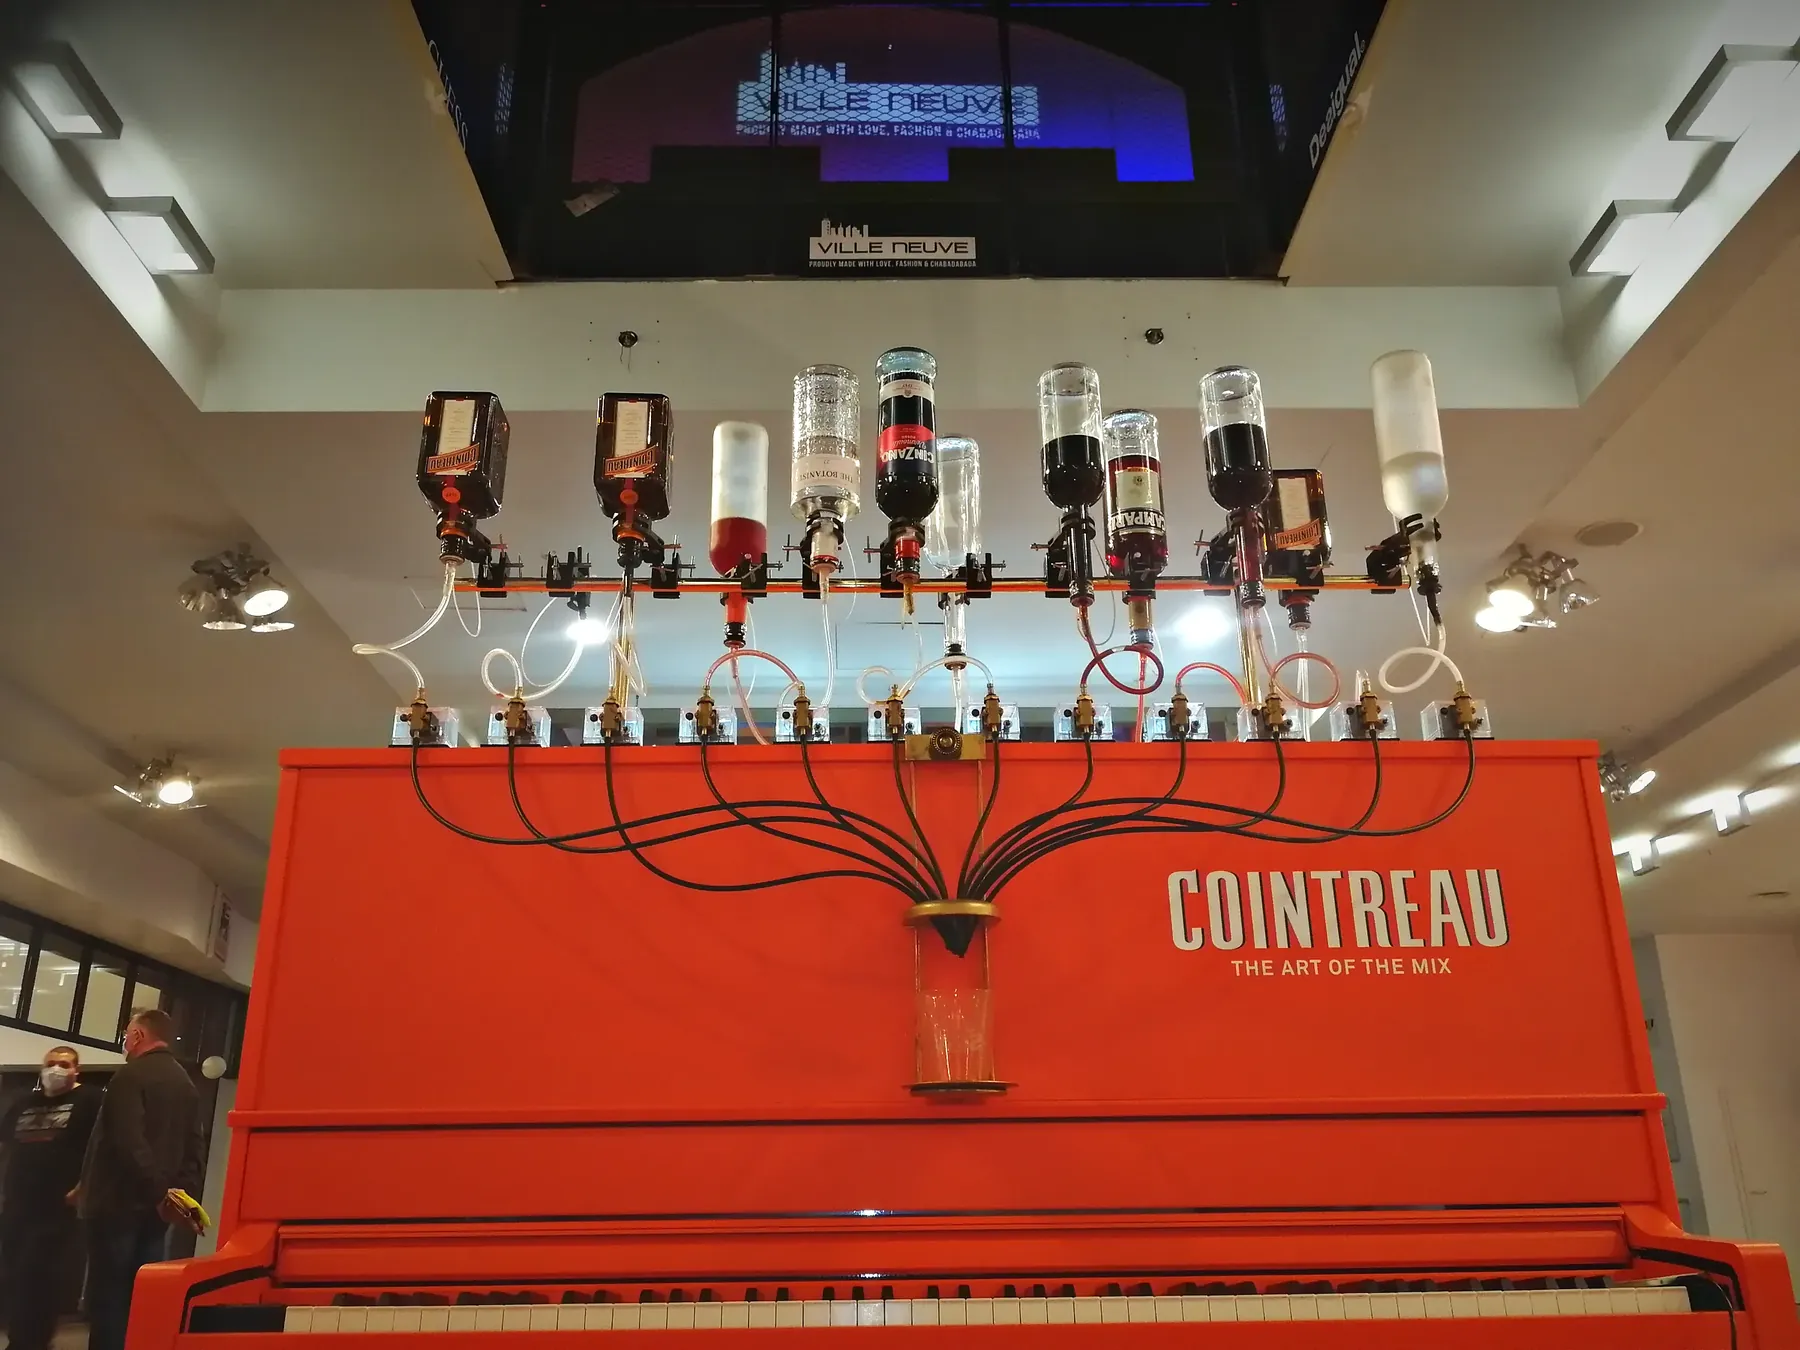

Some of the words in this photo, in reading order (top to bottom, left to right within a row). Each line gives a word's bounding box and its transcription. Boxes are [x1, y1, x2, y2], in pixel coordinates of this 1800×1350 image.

[735, 124, 786, 135] PROUDY
[826, 124, 854, 135] WITH
[956, 127, 1040, 140] CHABADBADA
[817, 242, 883, 254] VILLE
[892, 242, 968, 254] NEUVE
[881, 446, 935, 464] CINZANO
[1167, 868, 1510, 951] COINTREAU
[1231, 959, 1274, 976] THE
[1281, 959, 1321, 976] ART
[1328, 959, 1355, 976] OF
[1361, 958, 1405, 975] THE
[1411, 957, 1452, 975] MIX
